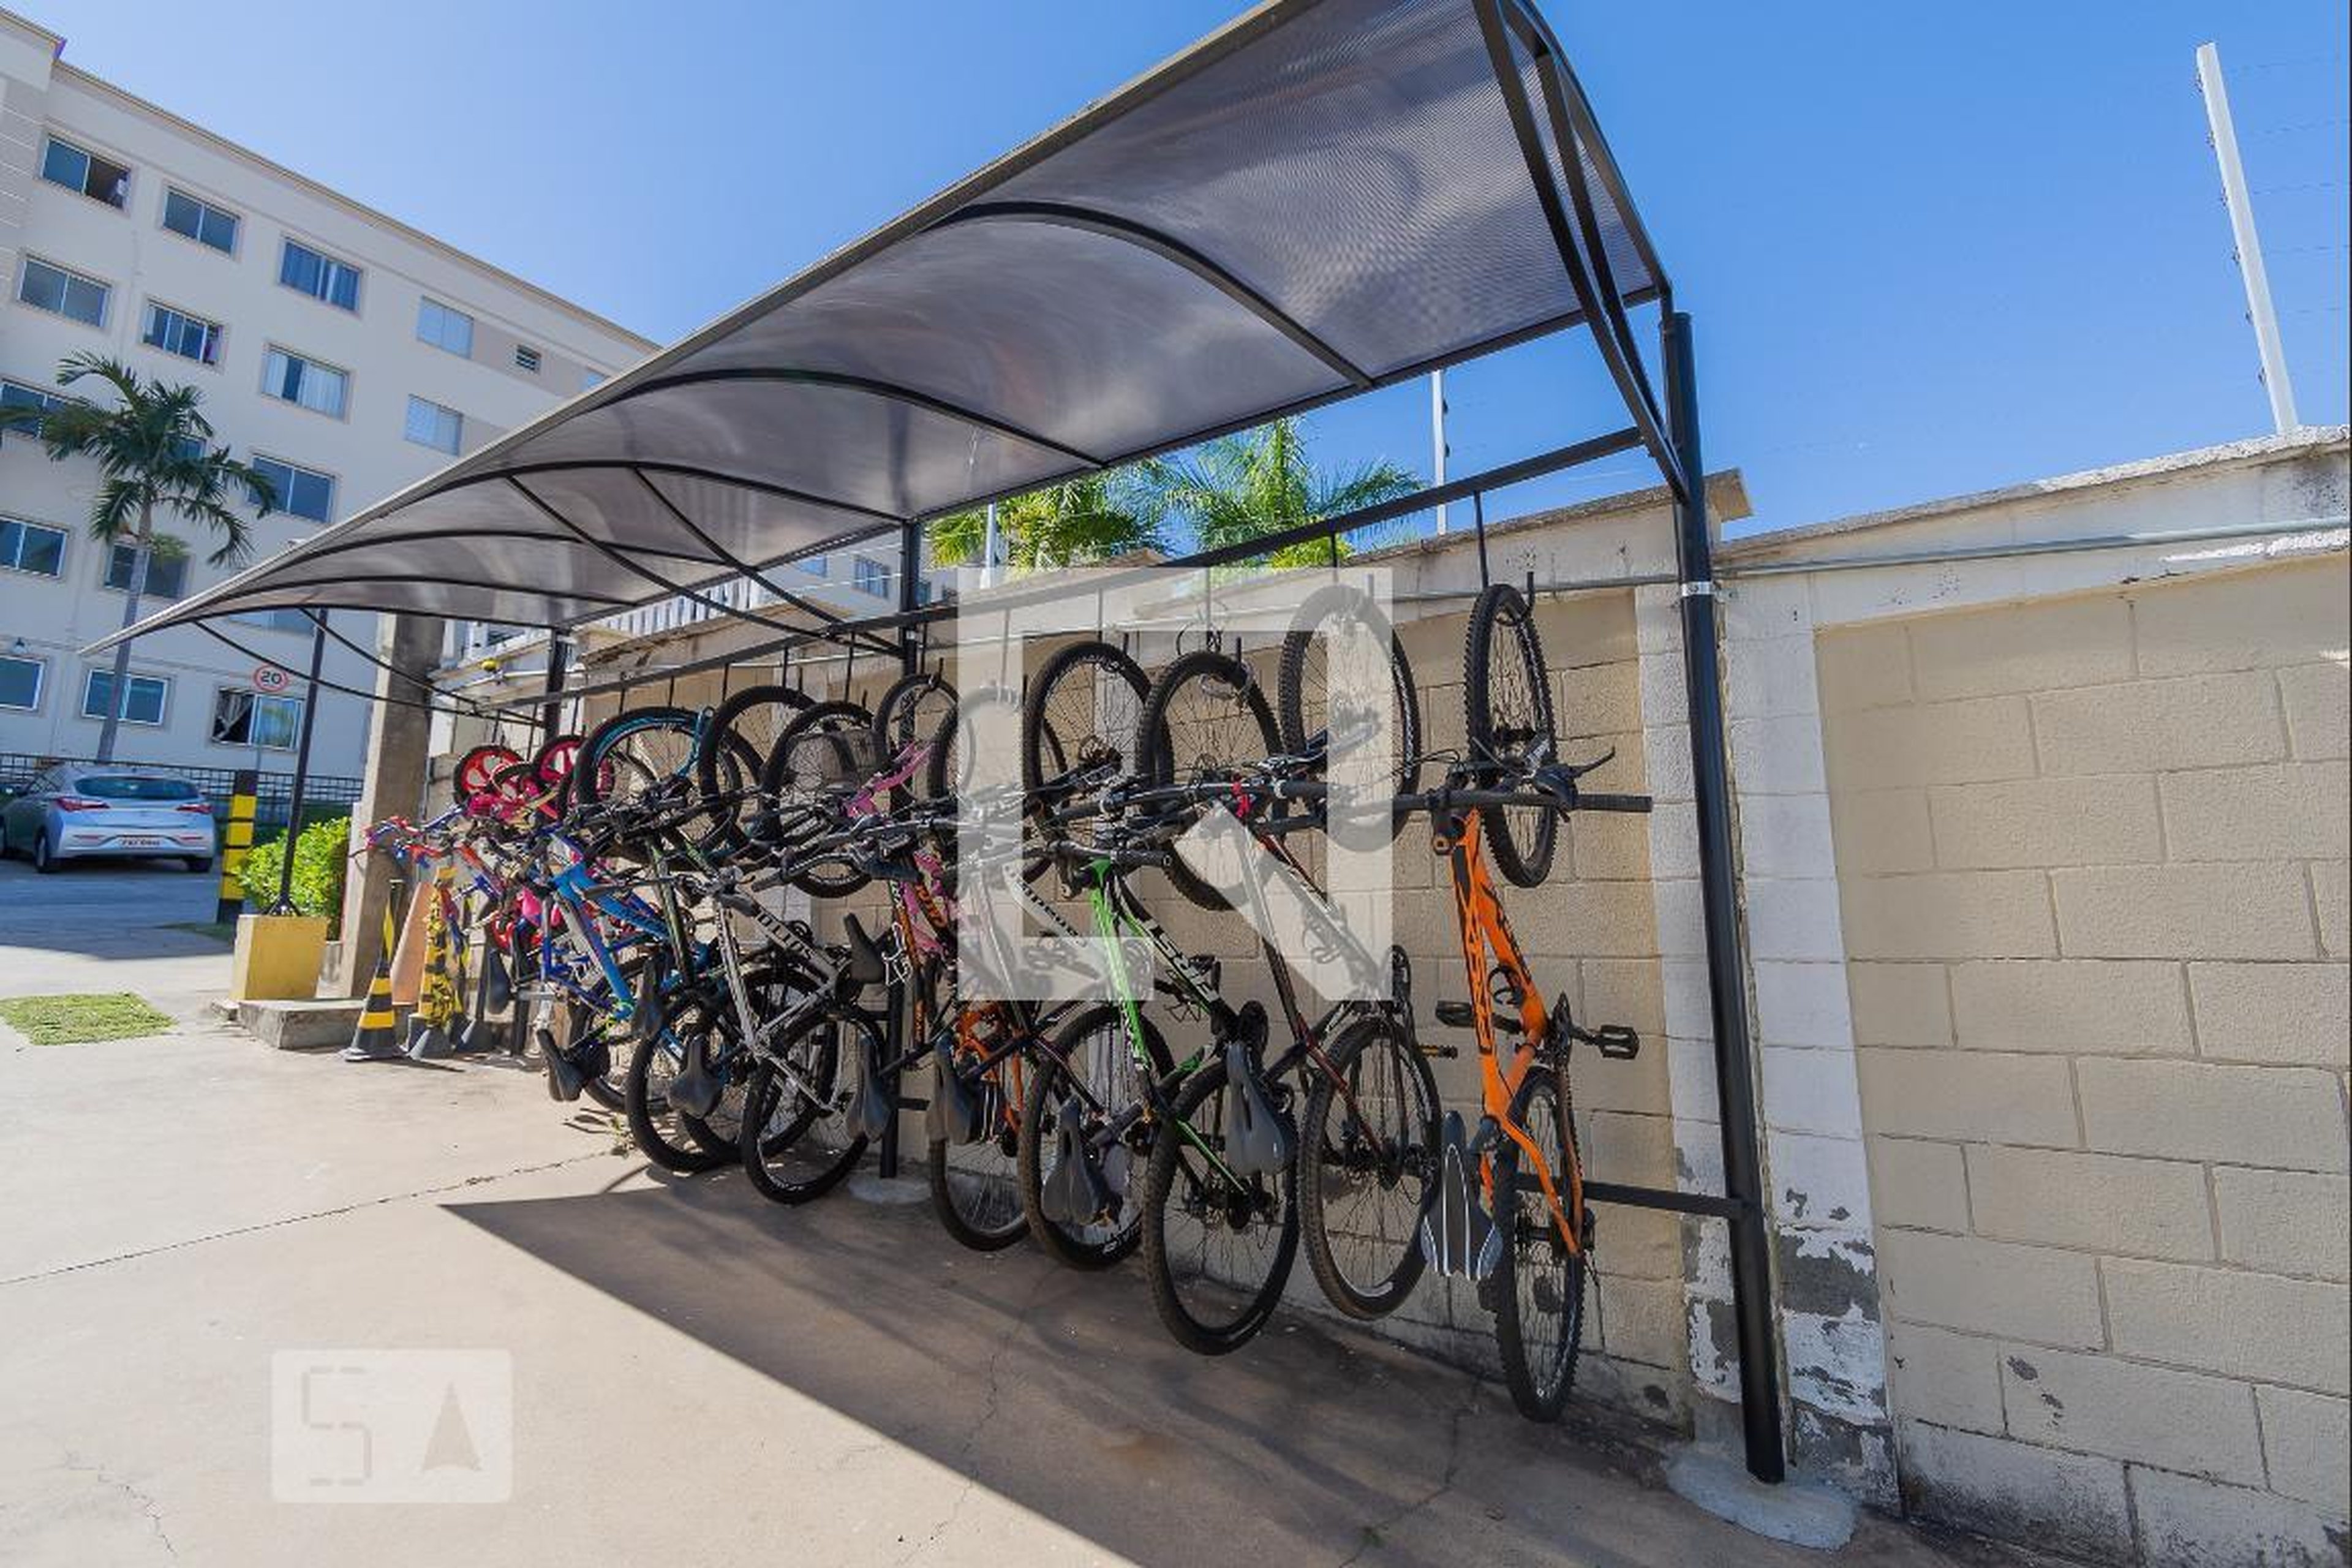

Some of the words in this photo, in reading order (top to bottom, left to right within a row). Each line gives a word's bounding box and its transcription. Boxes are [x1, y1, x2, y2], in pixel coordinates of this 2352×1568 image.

[261, 671, 282, 684] 20
[753, 910, 816, 960] SUTTO
[1144, 919, 1219, 1001] FIRST
